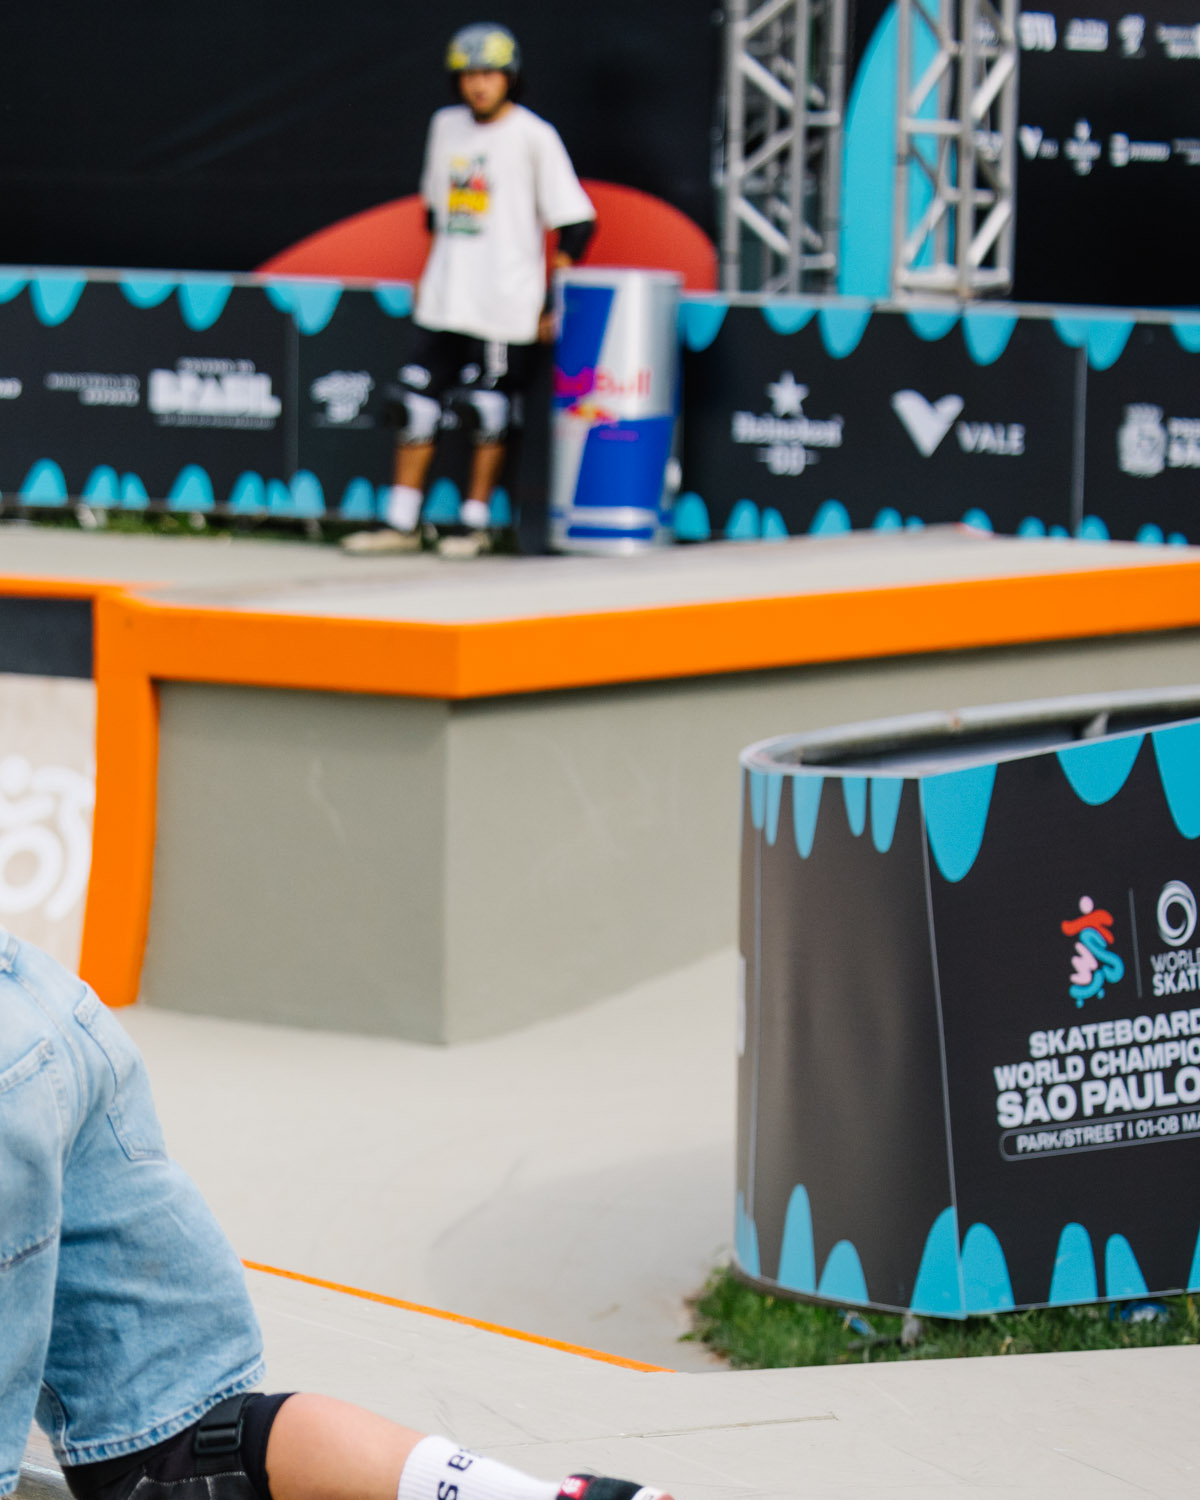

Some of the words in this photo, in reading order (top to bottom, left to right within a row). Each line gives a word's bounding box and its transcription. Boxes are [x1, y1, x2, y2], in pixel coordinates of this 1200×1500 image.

[956, 421, 1026, 456] VALE
[1152, 967, 1200, 997] SKAT
[994, 1055, 1085, 1092] WORLD
[1090, 1036, 1200, 1079] CHAMPIO
[996, 1083, 1077, 1129] SÃO
[1081, 1065, 1200, 1117] PAULO
[1016, 1122, 1125, 1153] PARK/STREET
